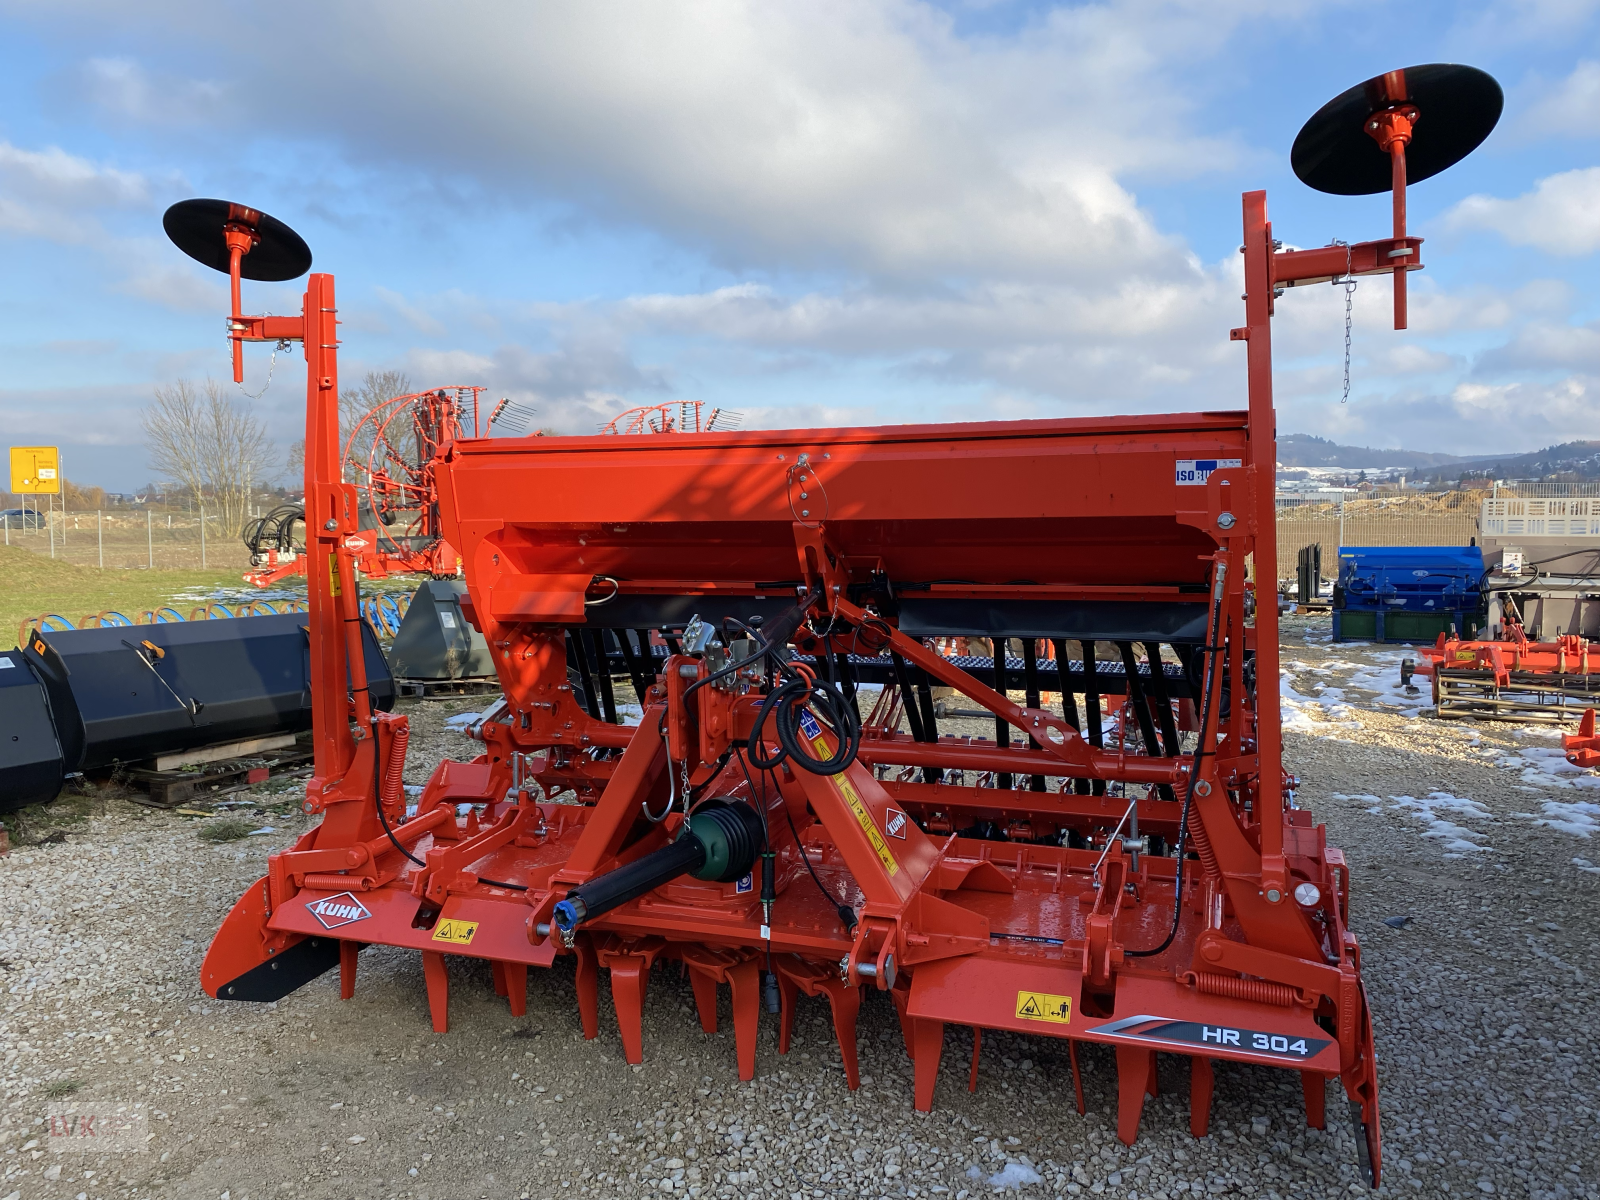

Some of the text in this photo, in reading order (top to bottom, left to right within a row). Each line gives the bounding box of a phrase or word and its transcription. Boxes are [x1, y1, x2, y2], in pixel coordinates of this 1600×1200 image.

[887, 813, 906, 836] KUHN
[315, 901, 363, 920] KUHN
[1202, 1026, 1309, 1055] HR 304
